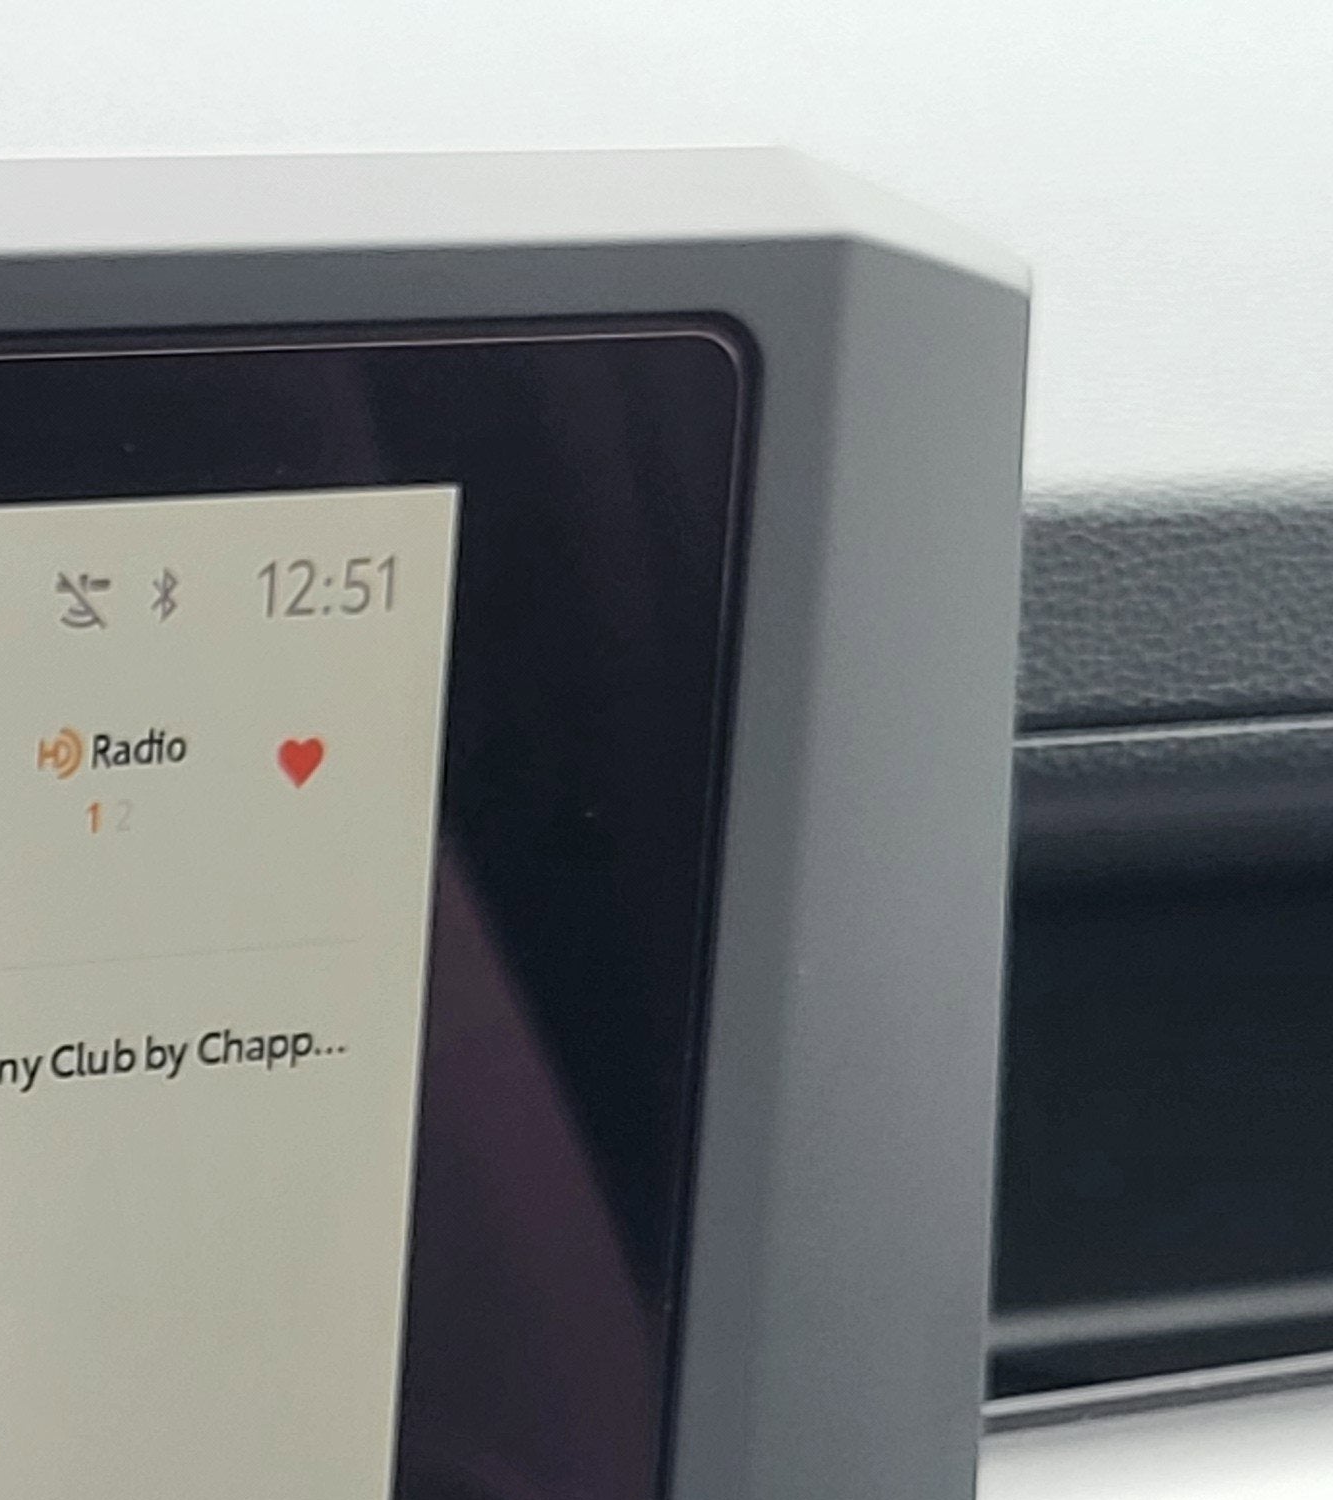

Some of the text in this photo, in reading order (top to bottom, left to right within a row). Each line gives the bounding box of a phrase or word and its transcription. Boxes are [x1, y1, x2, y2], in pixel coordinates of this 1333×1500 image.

[256, 555, 400, 619] 12:51
[91, 727, 187, 769] Radio
[51, 1038, 135, 1079] Club
[146, 1036, 187, 1079] by
[198, 1029, 346, 1070] Chapp...
